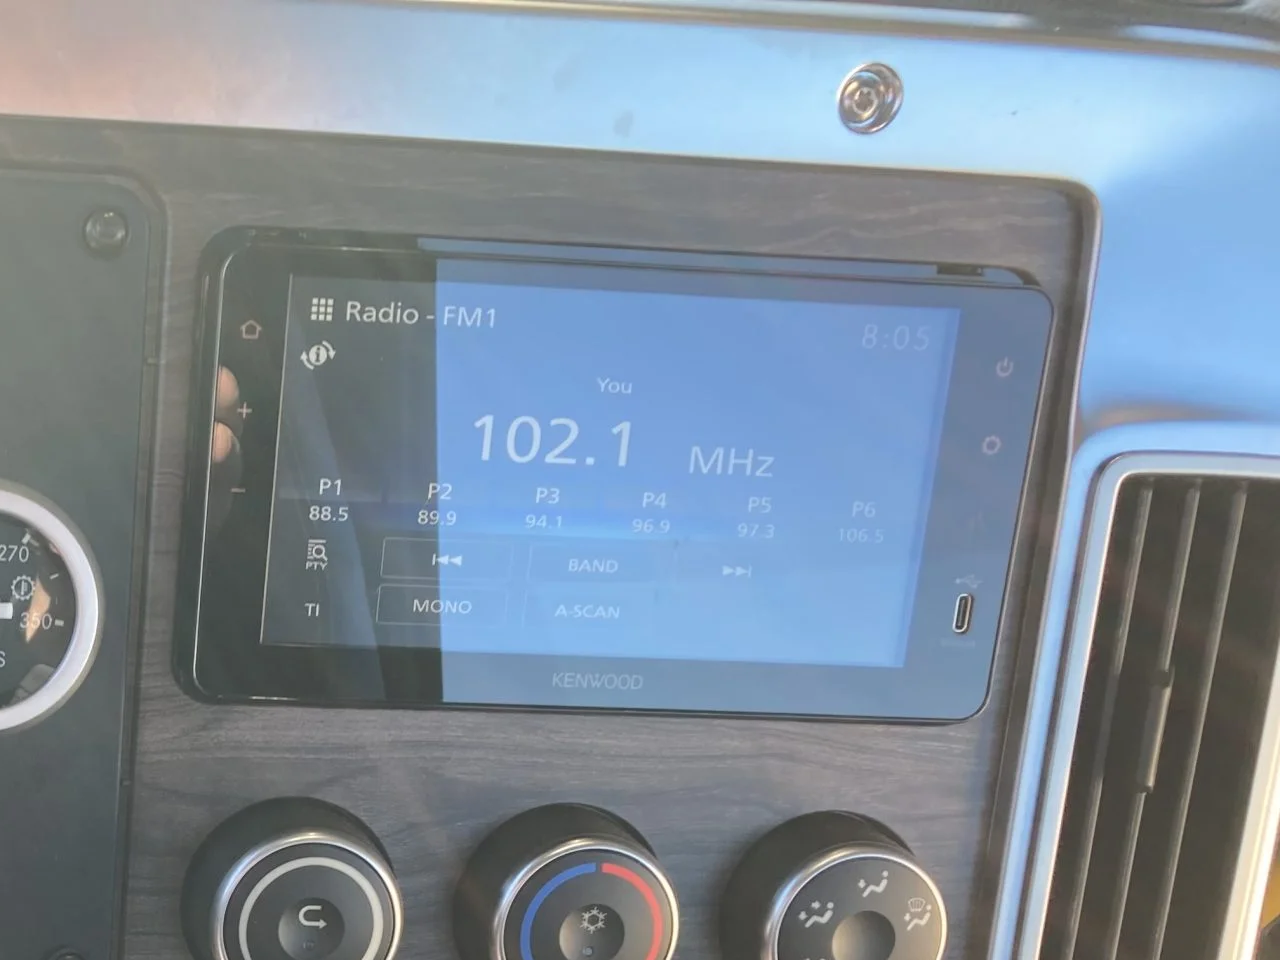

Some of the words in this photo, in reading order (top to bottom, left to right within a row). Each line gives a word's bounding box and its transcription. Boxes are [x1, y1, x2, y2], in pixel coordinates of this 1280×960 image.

[346, 301, 419, 325] Radio
[443, 305, 496, 328] FM1
[861, 324, 931, 351] 8:05
[597, 377, 632, 394] You
[474, 413, 631, 467] 102.1
[688, 444, 774, 477] MHz
[319, 479, 342, 496] P1
[427, 482, 452, 500] P2
[535, 487, 560, 504] P3
[642, 491, 667, 509] P4
[747, 496, 771, 514] P5
[308, 506, 349, 522] 88.5
[417, 510, 457, 526] 89.9
[852, 501, 876, 518] P6
[525, 514, 563, 530] 94.1
[632, 519, 670, 534] 96.9
[737, 523, 775, 539] 97.3
[839, 527, 884, 543] 106.5
[305, 560, 328, 571] PTY
[568, 558, 619, 574] BAND
[412, 598, 472, 615] MONO
[555, 604, 620, 619] A-SCAN
[20, 612, 52, 629] 350
[552, 671, 644, 691] KENWOOD
